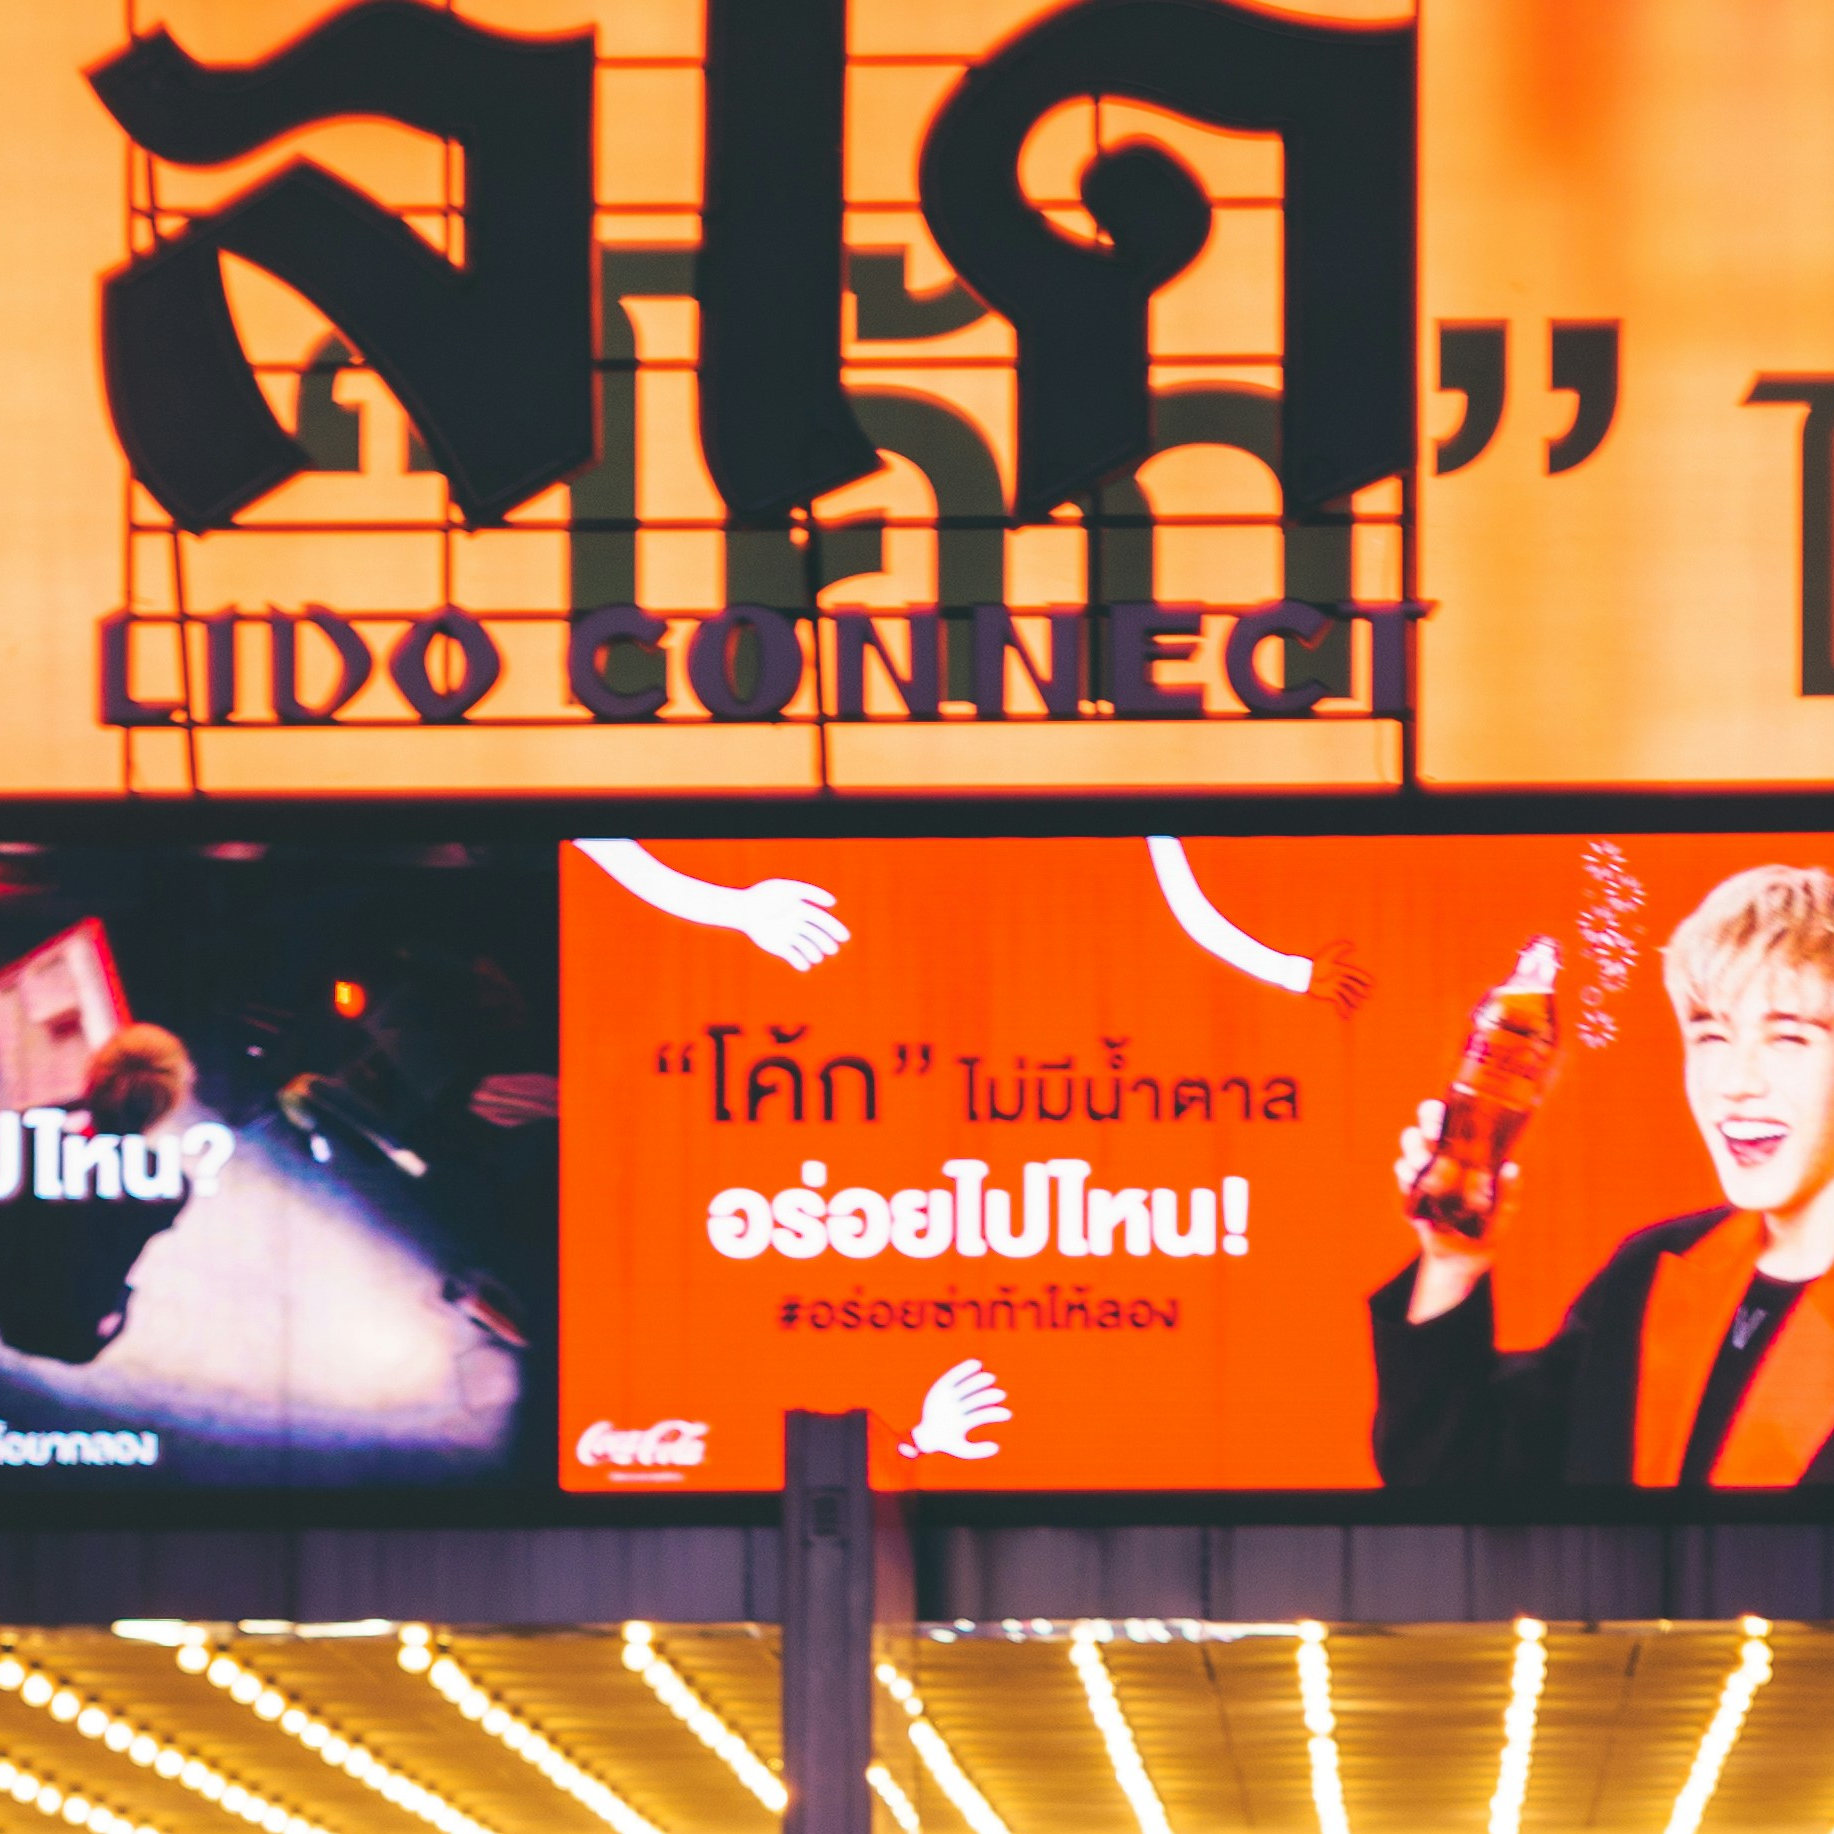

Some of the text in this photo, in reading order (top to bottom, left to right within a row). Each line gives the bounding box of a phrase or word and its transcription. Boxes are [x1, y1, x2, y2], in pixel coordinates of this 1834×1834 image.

[97, 599, 1438, 727] LIDO CONNECT
[654, 1024, 1301, 1123] “โค้ก” ไม่มีน้ำตาล
[707, 1158, 1250, 1257] อร่อยไปไหน!
